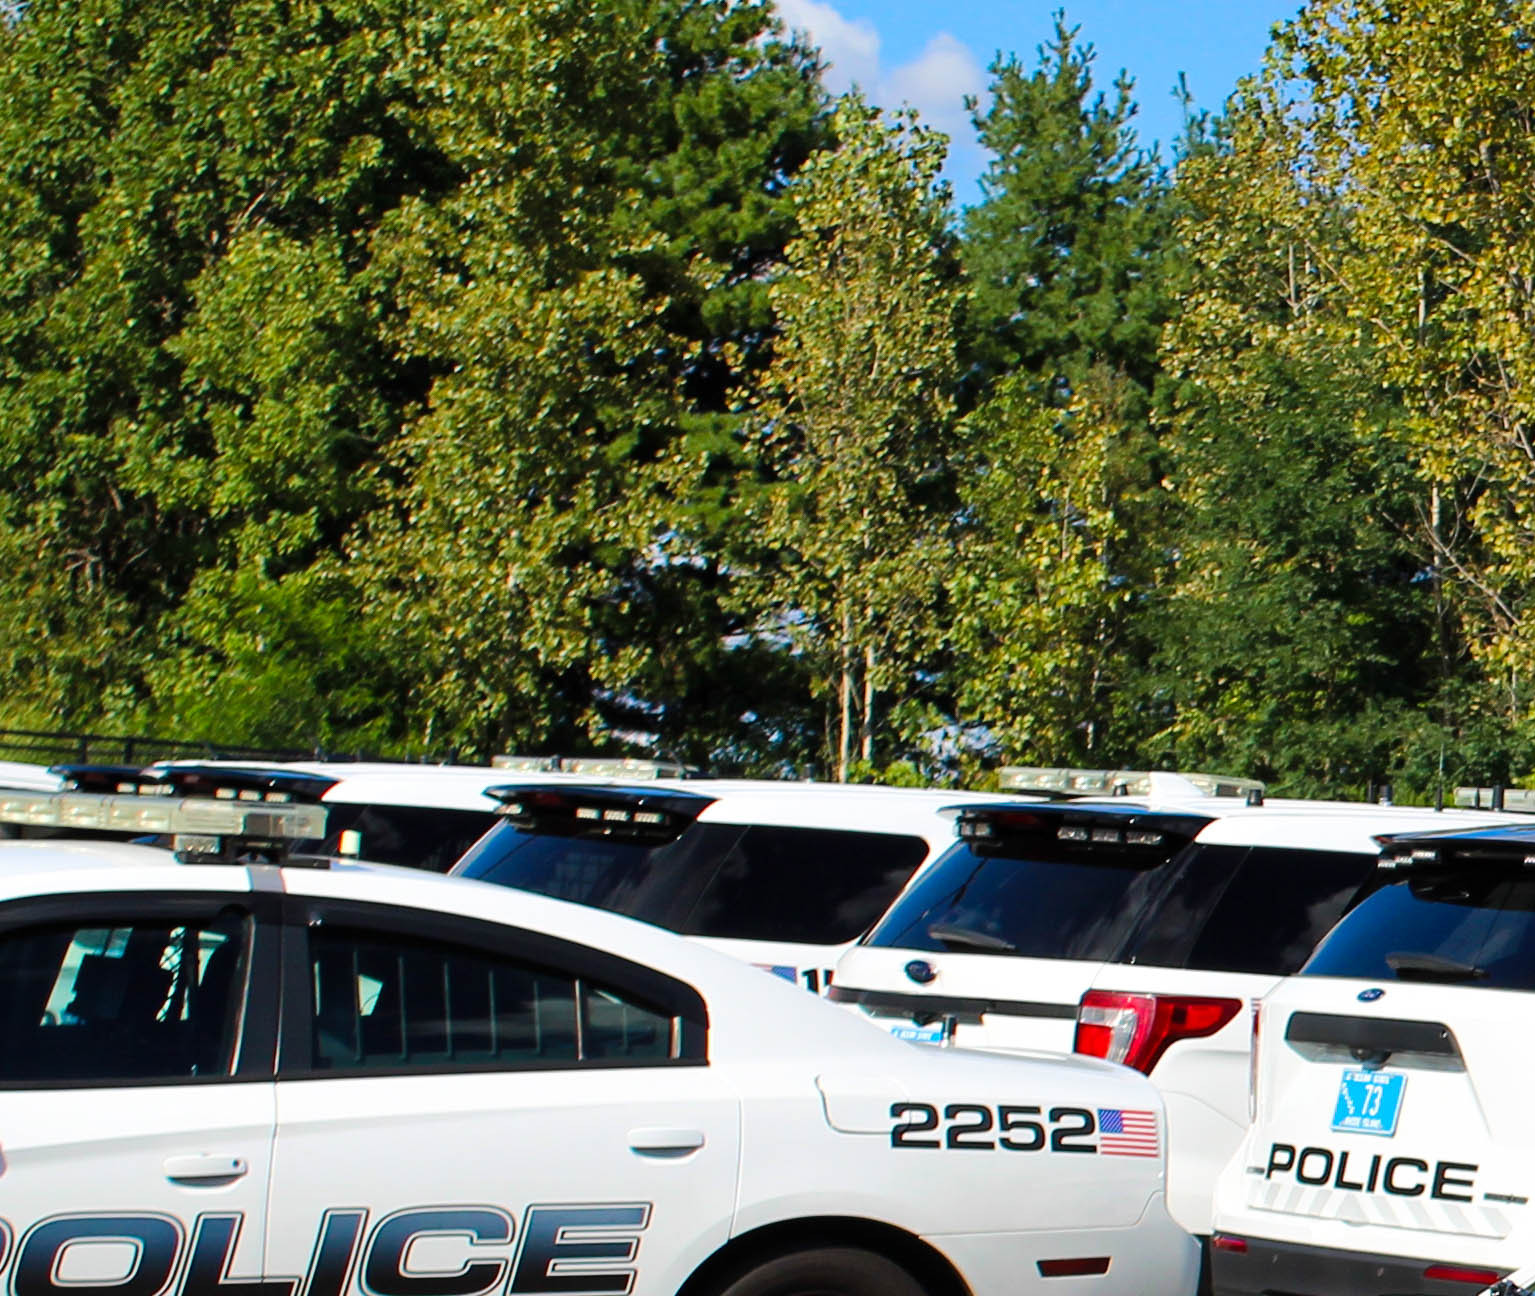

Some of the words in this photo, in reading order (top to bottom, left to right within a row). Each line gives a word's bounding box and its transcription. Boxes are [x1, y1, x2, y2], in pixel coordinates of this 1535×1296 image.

[1361, 1084, 1383, 1116] 73
[890, 1102, 1097, 1153] 2252
[1265, 1143, 1479, 1202] POLICE
